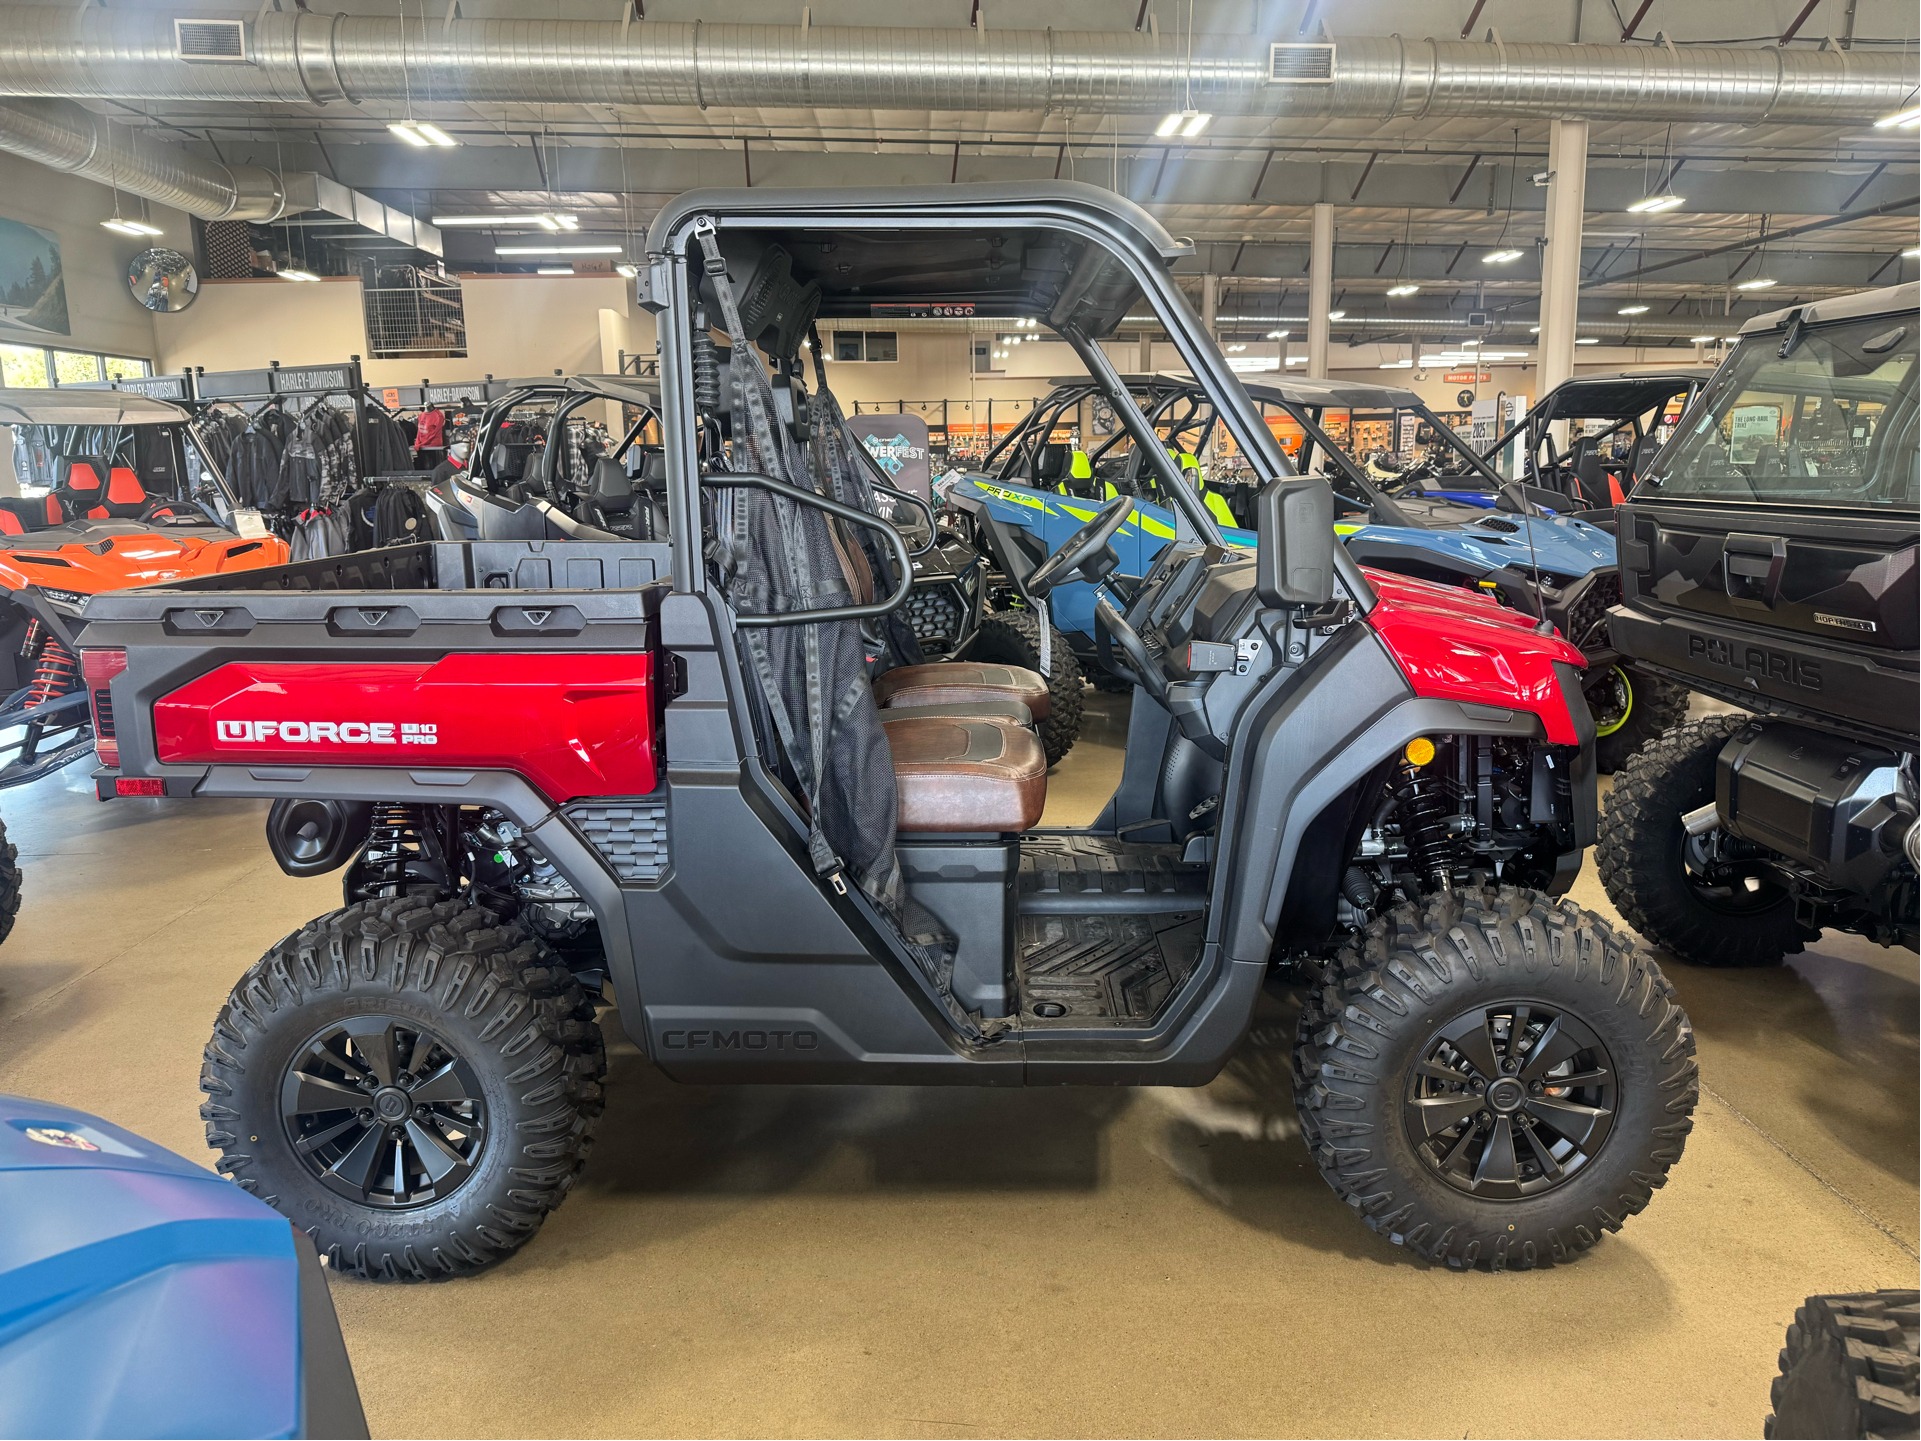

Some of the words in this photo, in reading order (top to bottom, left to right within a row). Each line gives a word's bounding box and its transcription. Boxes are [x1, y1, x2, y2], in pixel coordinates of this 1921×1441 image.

[280, 370, 345, 390] HARLEY-DAVIDSON
[429, 386, 480, 402] HARLEY-DAVIDSON
[1473, 422, 1486, 439] 2025
[867, 445, 925, 460] WERFEST
[986, 485, 1012, 498] PRO
[1012, 493, 1033, 502] XP
[1688, 633, 1824, 691] POLARIS
[401, 734, 438, 745] PRO
[662, 1030, 819, 1050] CFMOTO
